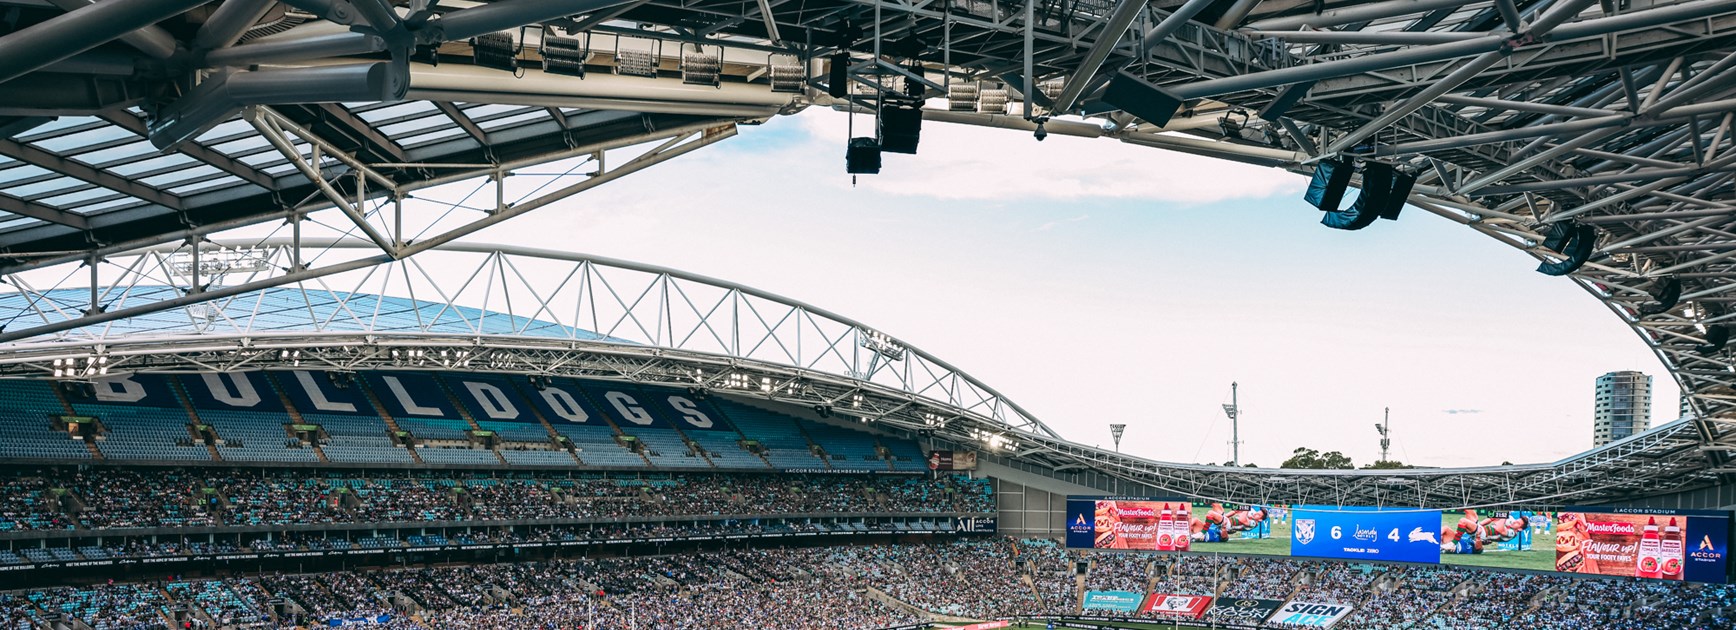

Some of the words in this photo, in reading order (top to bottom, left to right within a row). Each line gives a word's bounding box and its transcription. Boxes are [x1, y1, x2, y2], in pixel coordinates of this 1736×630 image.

[93, 371, 713, 428] BULLDOGS
[1330, 525, 1342, 539] 6
[1586, 522, 1635, 533] MasterFoods
[1387, 527, 1400, 542] 4
[1285, 603, 1345, 616] SIGN
[1282, 613, 1334, 626] ACE
